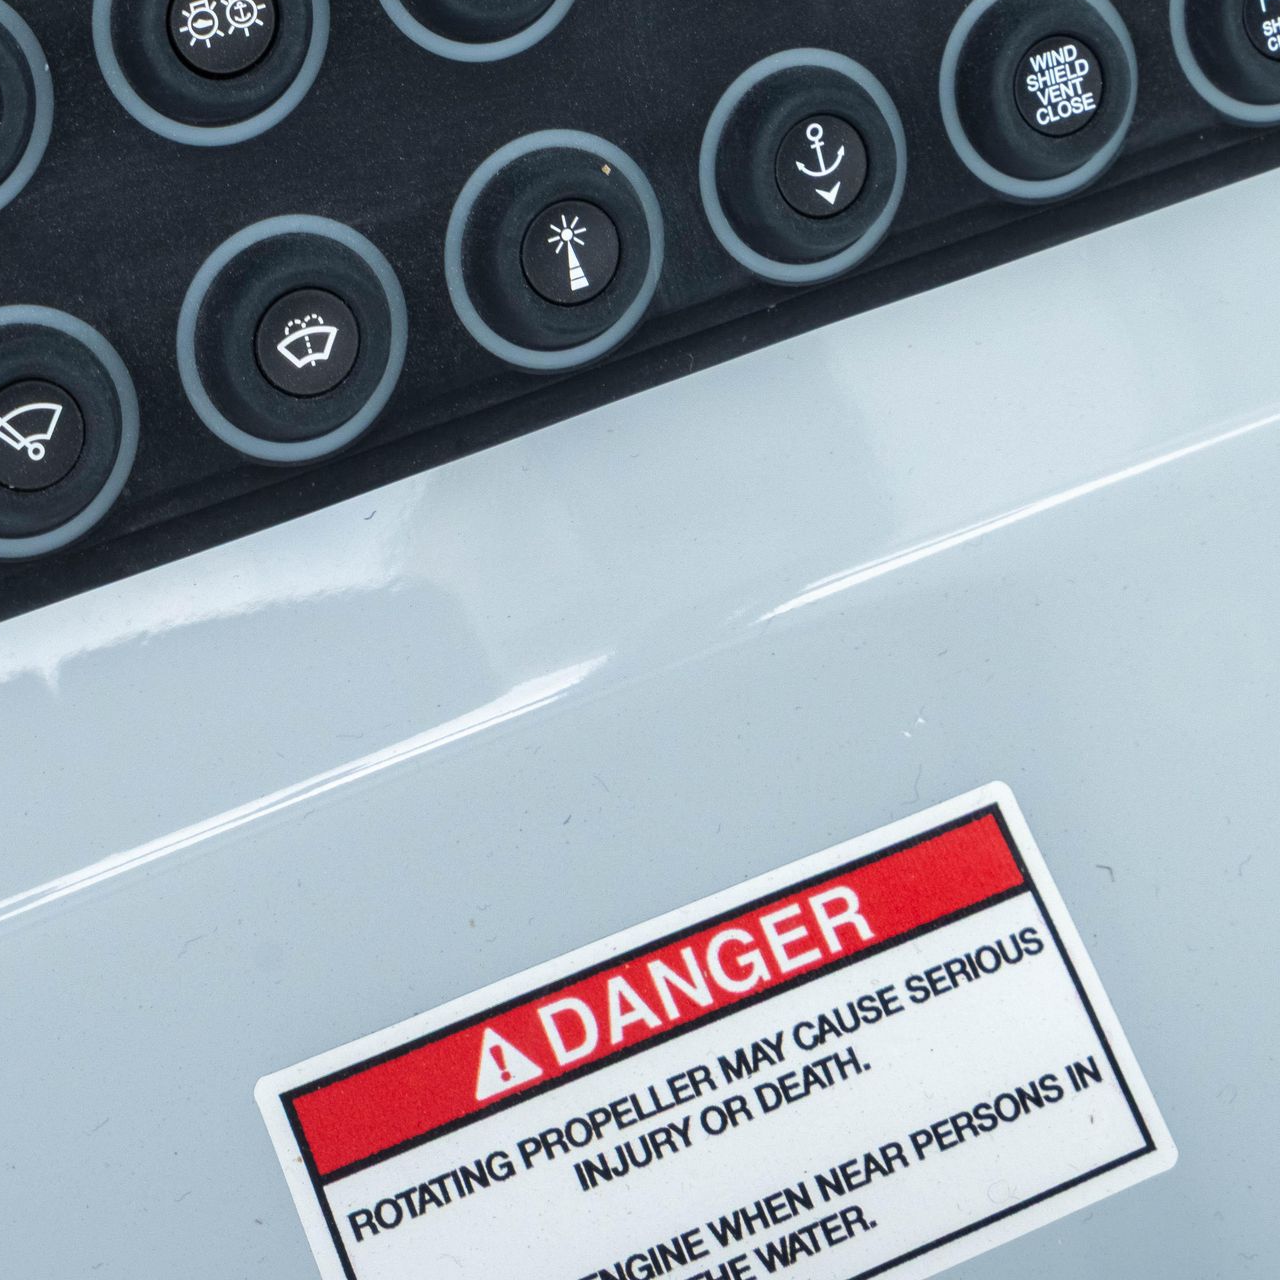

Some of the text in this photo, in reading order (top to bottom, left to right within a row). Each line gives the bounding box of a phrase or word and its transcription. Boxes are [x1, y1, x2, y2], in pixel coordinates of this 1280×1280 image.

[1026, 58, 1089, 92] SHIELD
[1029, 44, 1078, 73] WIND
[1036, 77, 1084, 107] VENT
[1036, 92, 1097, 125] CLOSE
[536, 885, 875, 1066] DANGER
[347, 927, 1045, 1242] ROTATING PROPELLER MAY CAUSE SERIOUS
[573, 1047, 872, 1192] INJURY OR DEATH.
[578, 1055, 1103, 1280] NGINE WHEN NEAR PERSONS IN
[753, 1205, 878, 1273] WATER.
